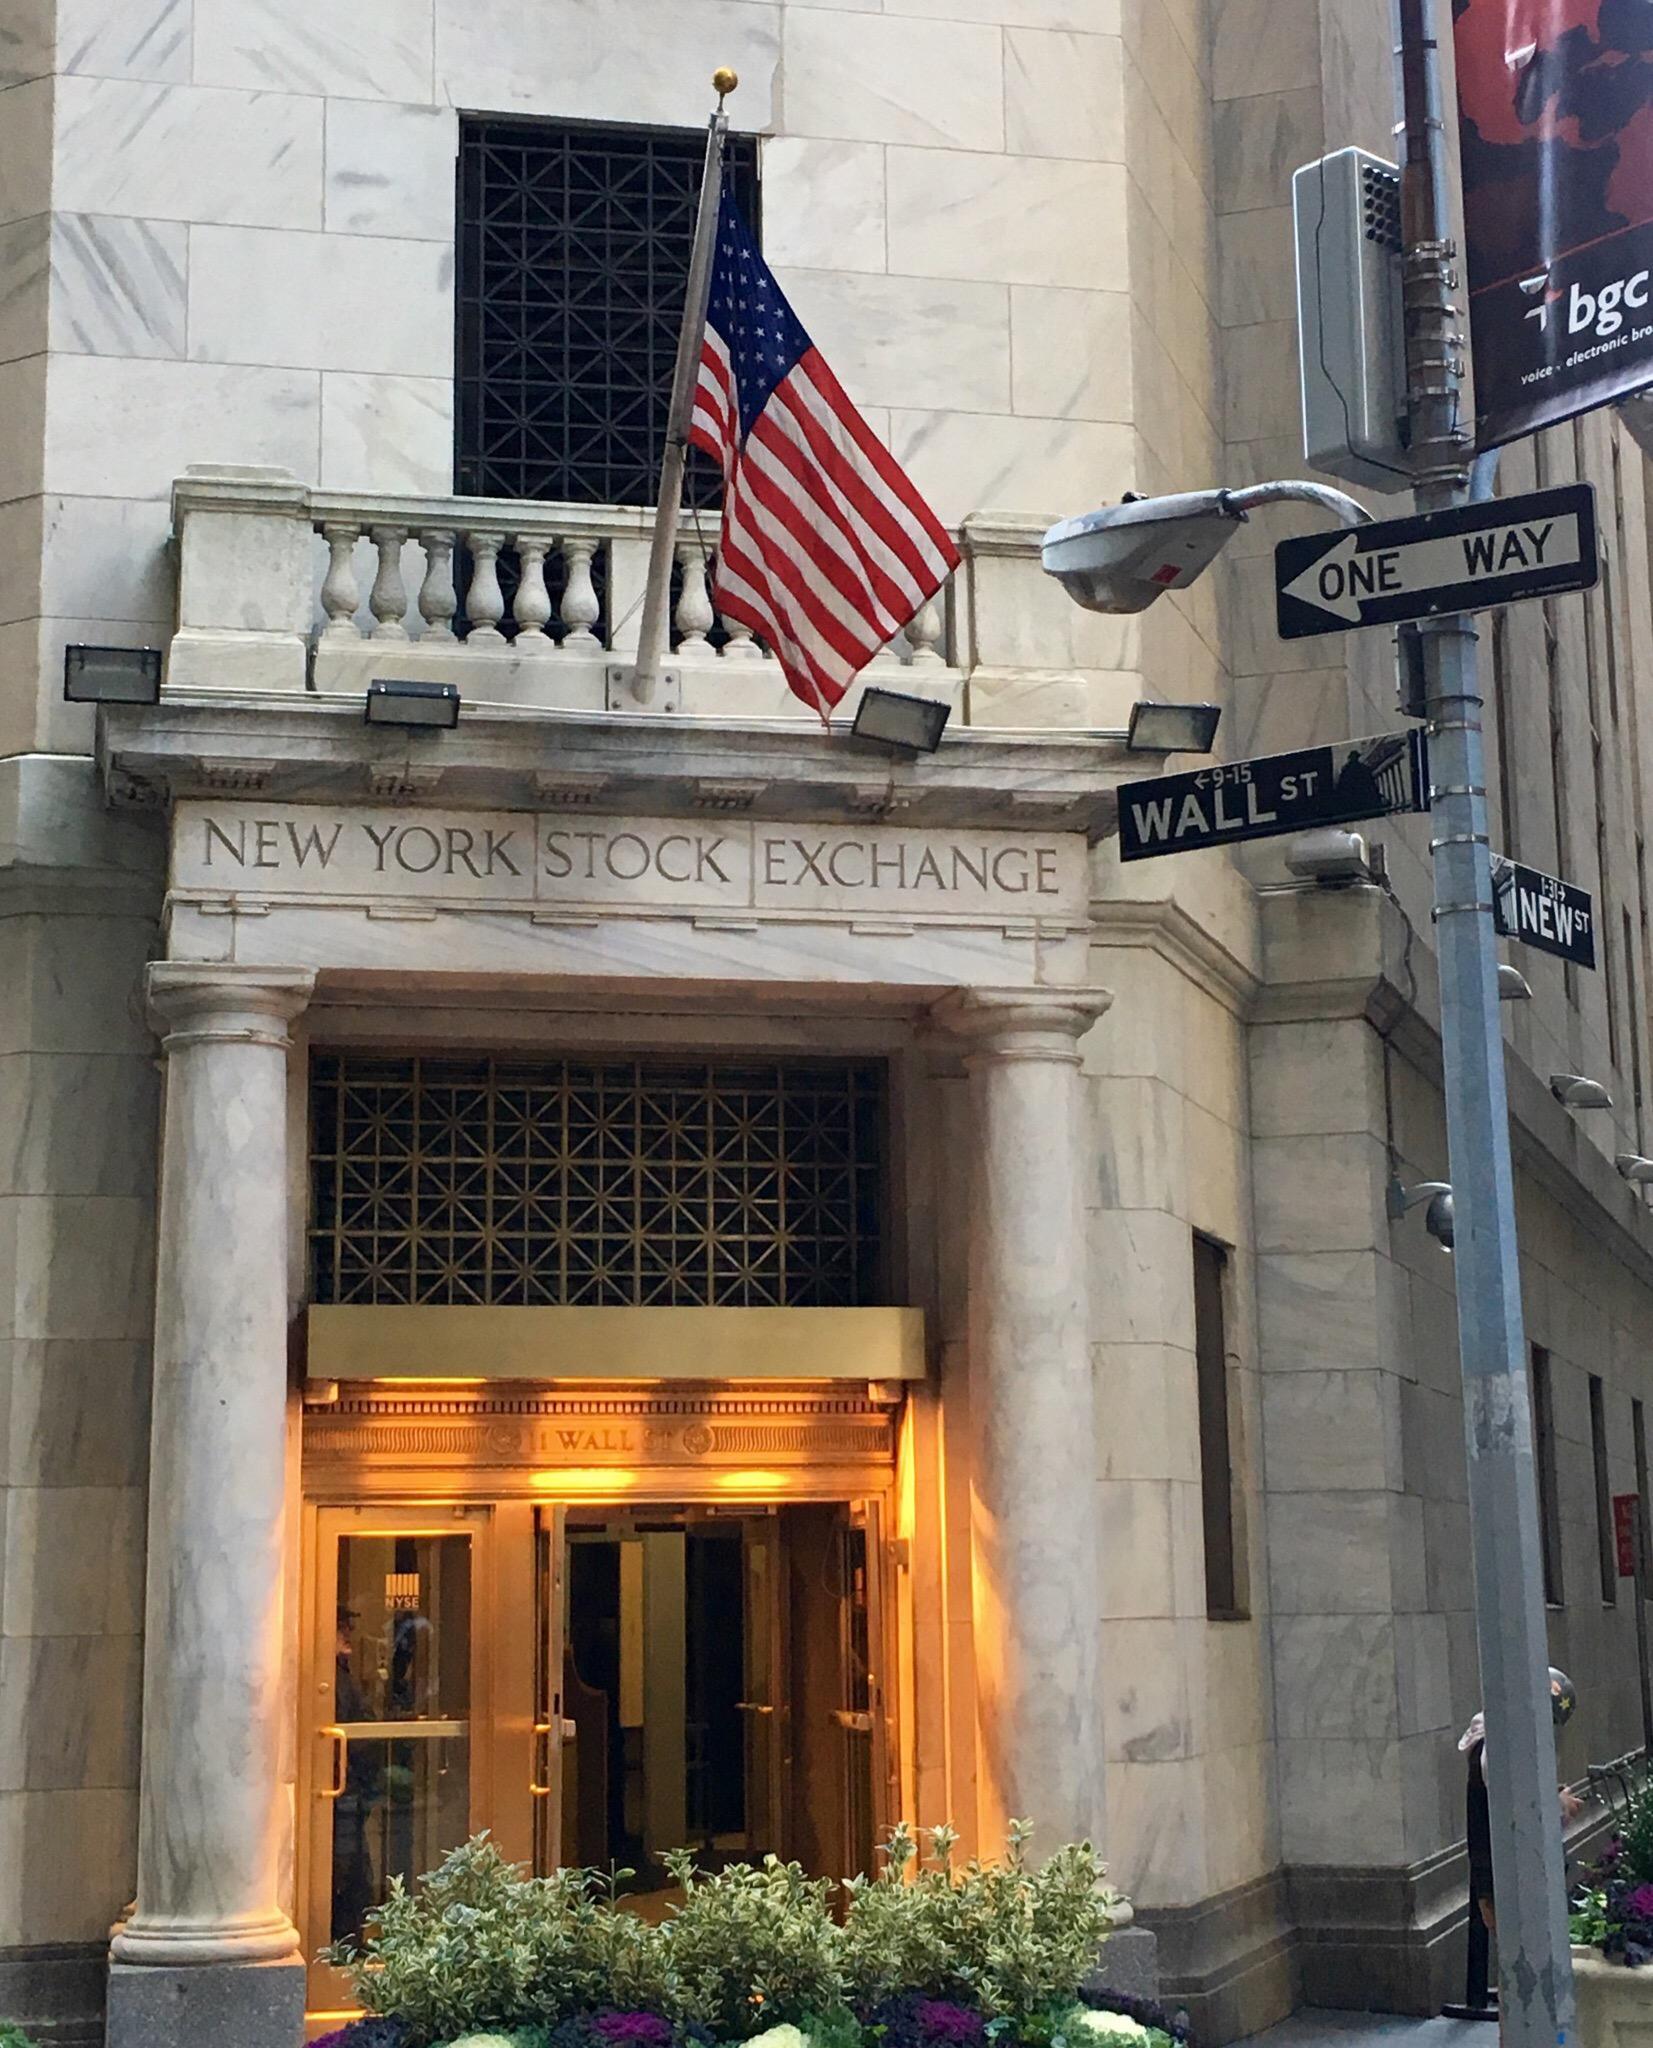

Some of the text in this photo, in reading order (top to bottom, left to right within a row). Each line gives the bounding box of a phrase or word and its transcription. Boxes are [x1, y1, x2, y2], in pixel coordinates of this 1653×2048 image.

[1568, 270, 1649, 336] bgc
[1521, 325, 1653, 385] voice electronic bro
[1319, 523, 1553, 601] ONE WAY
[1211, 764, 1252, 788] 9-15
[1131, 771, 1318, 844] WALL ST
[202, 818, 1059, 895] NEW YORK STOCK EXCHANGE
[1520, 887, 1589, 947] NEW ST
[556, 1429, 634, 1451] WALL
[385, 1597, 419, 1608] NYSE
